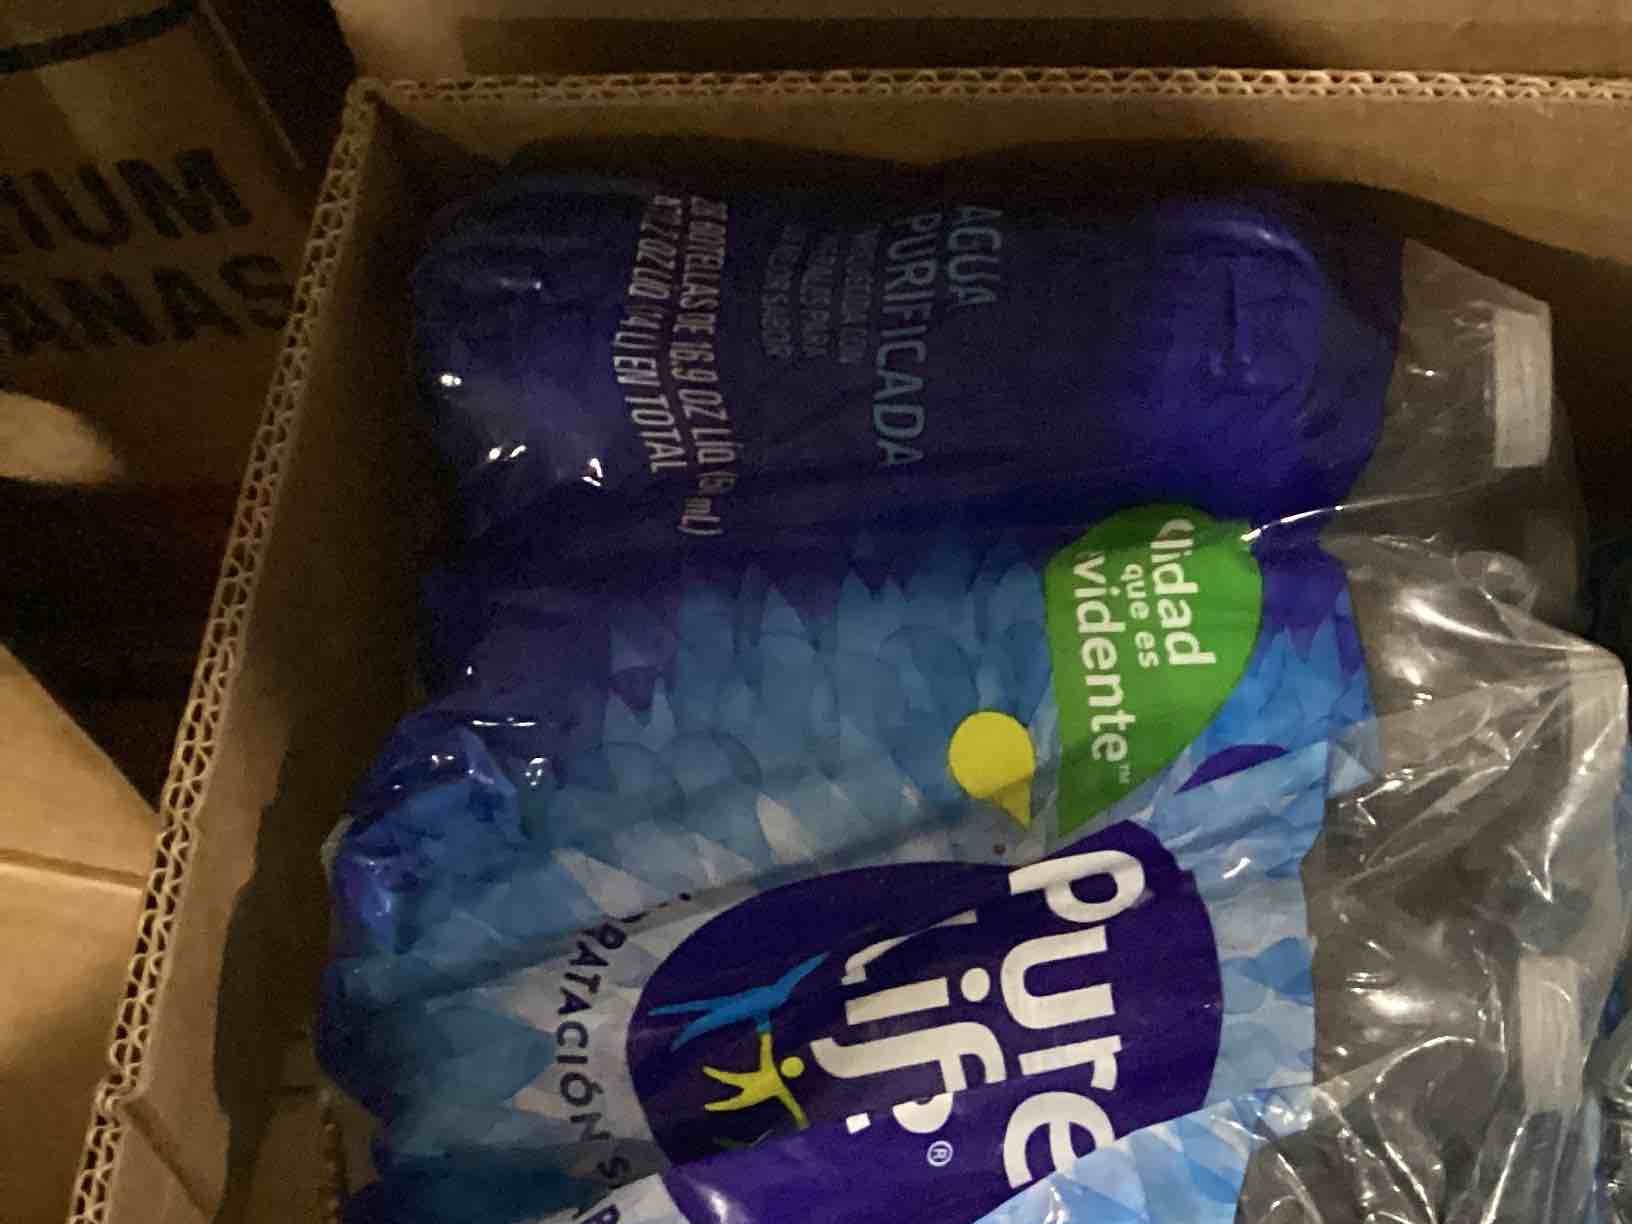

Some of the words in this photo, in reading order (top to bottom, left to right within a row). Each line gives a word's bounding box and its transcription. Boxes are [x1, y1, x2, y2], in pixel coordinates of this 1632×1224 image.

[935, 206, 1002, 306] AGUA
[613, 355, 663, 387] EN
[872, 212, 942, 466] PURIFICADA
[625, 395, 688, 473] TOTAL
[679, 389, 727, 422] OZ
[1120, 563, 1149, 621] que
[1134, 630, 1160, 668] es
[1003, 850, 1145, 1188] Pure
